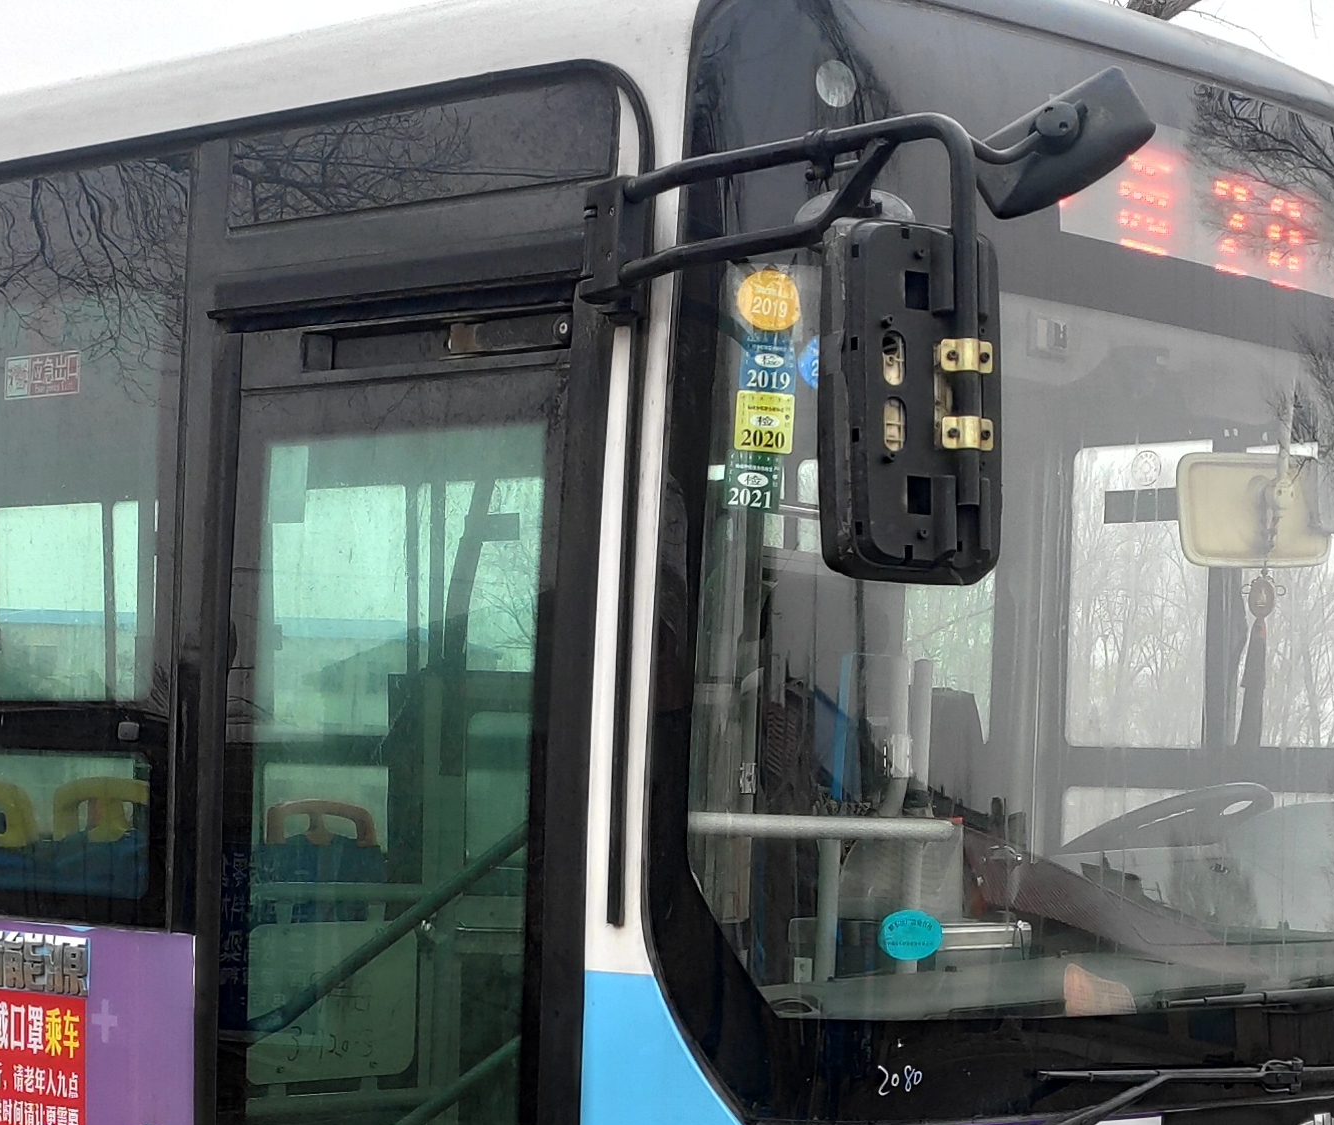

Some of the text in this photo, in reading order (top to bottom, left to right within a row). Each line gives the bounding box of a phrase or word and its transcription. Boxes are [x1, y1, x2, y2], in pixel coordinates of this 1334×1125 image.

[751, 296, 787, 318] 2019
[746, 369, 791, 390] 2019
[741, 429, 785, 449] 2020
[727, 487, 772, 509] 2021
[877, 1065, 923, 1096] 2080
